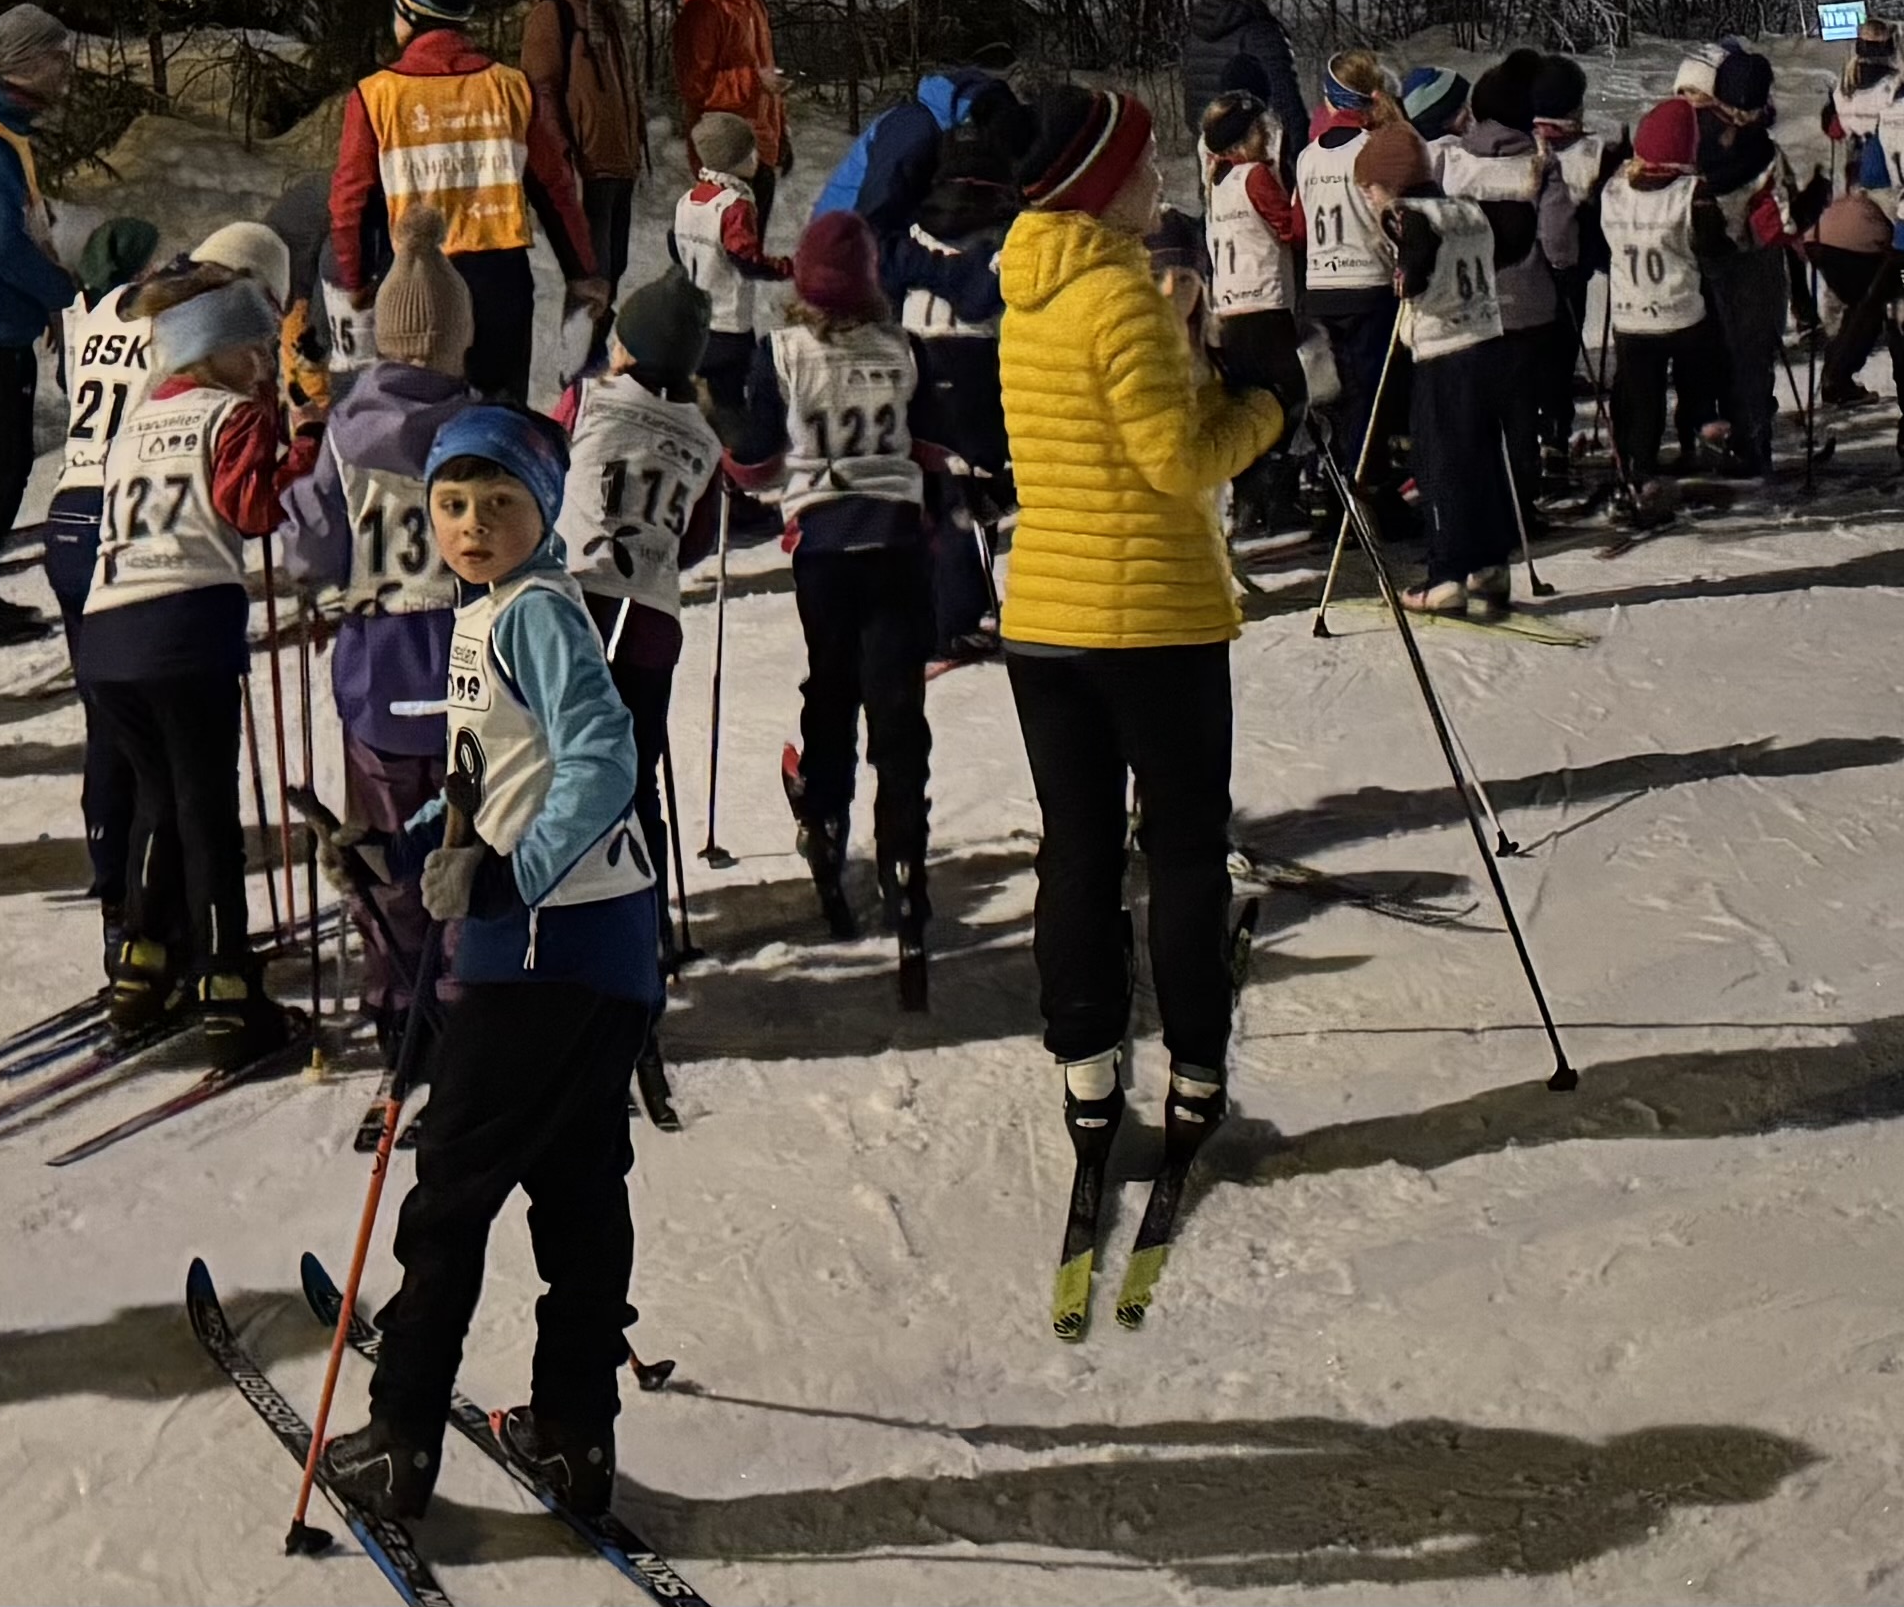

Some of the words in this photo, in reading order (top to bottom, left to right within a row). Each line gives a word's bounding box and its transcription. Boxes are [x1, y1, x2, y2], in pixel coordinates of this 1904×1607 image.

[1315, 204, 1343, 247] 61
[80, 334, 148, 371] BSK
[69, 380, 128, 440] 21
[805, 403, 898, 457] 122
[106, 473, 193, 542] 127
[358, 504, 450, 576] 13
[626, 1553, 694, 1597] SKIN
